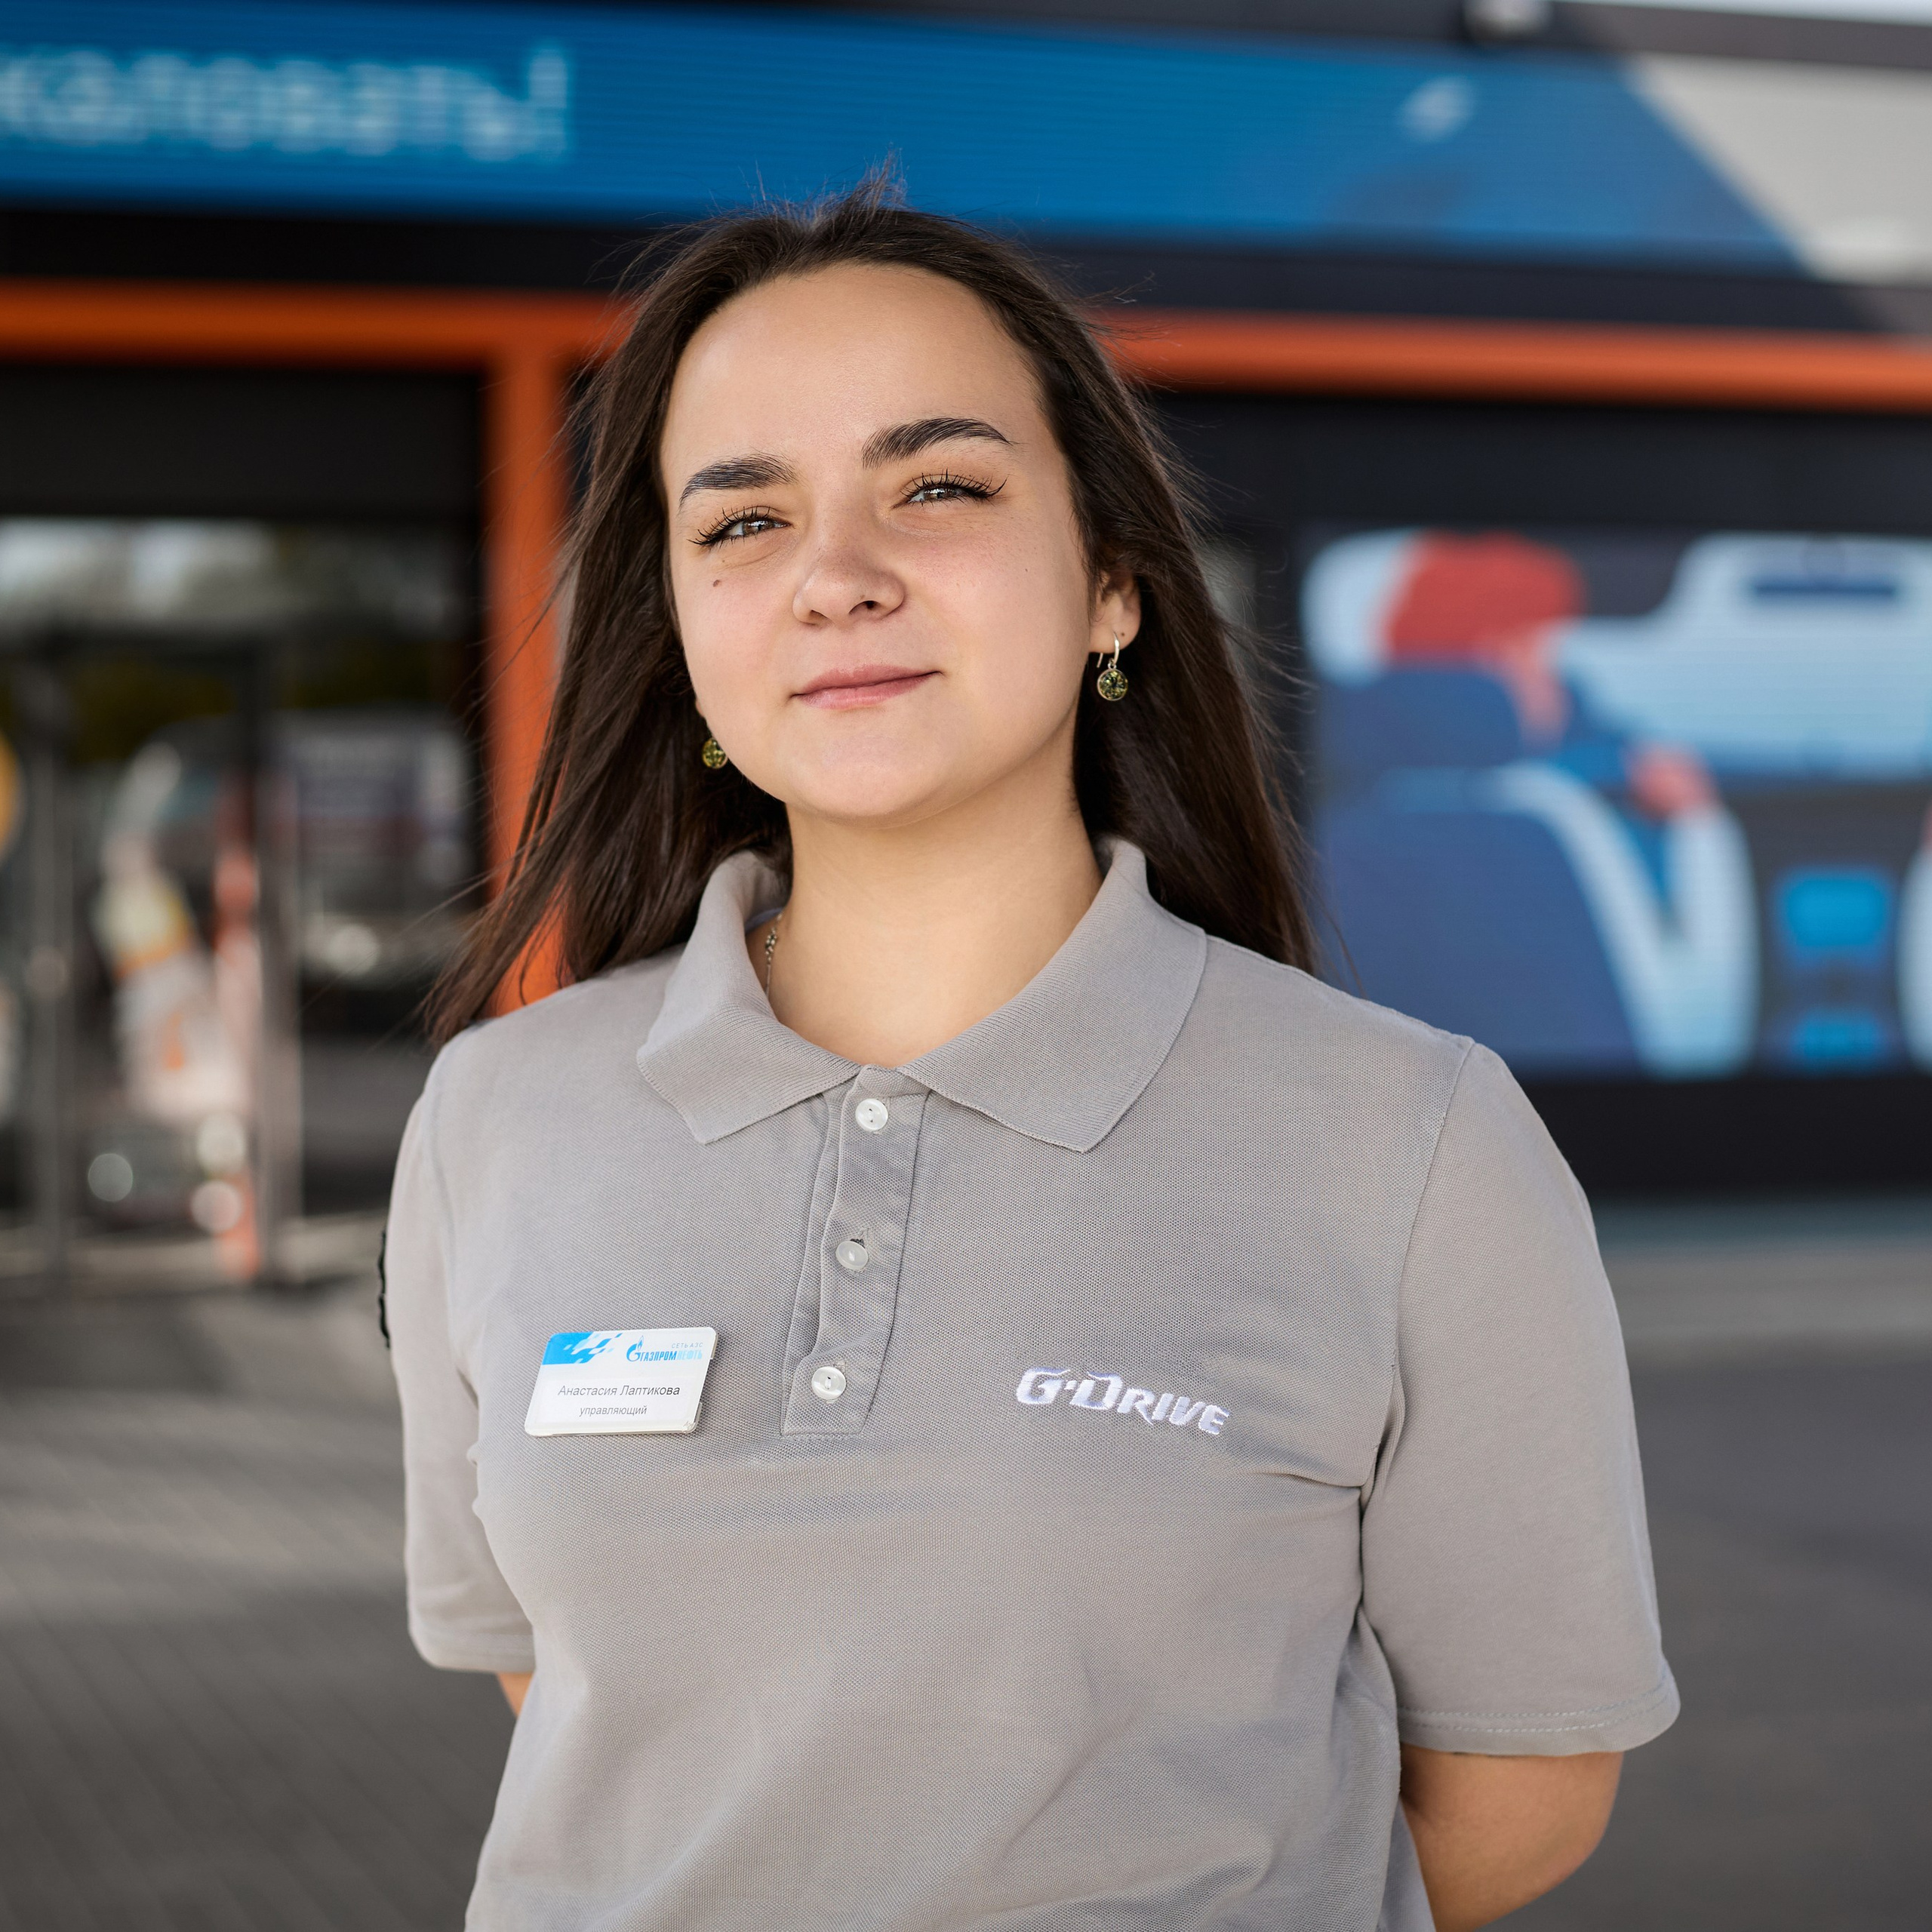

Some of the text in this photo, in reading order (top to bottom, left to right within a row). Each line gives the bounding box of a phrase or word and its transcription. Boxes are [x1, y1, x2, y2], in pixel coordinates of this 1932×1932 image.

[557, 1385, 681, 1396] Анастасия Лаптикова
[579, 1405, 648, 1417] управляющий
